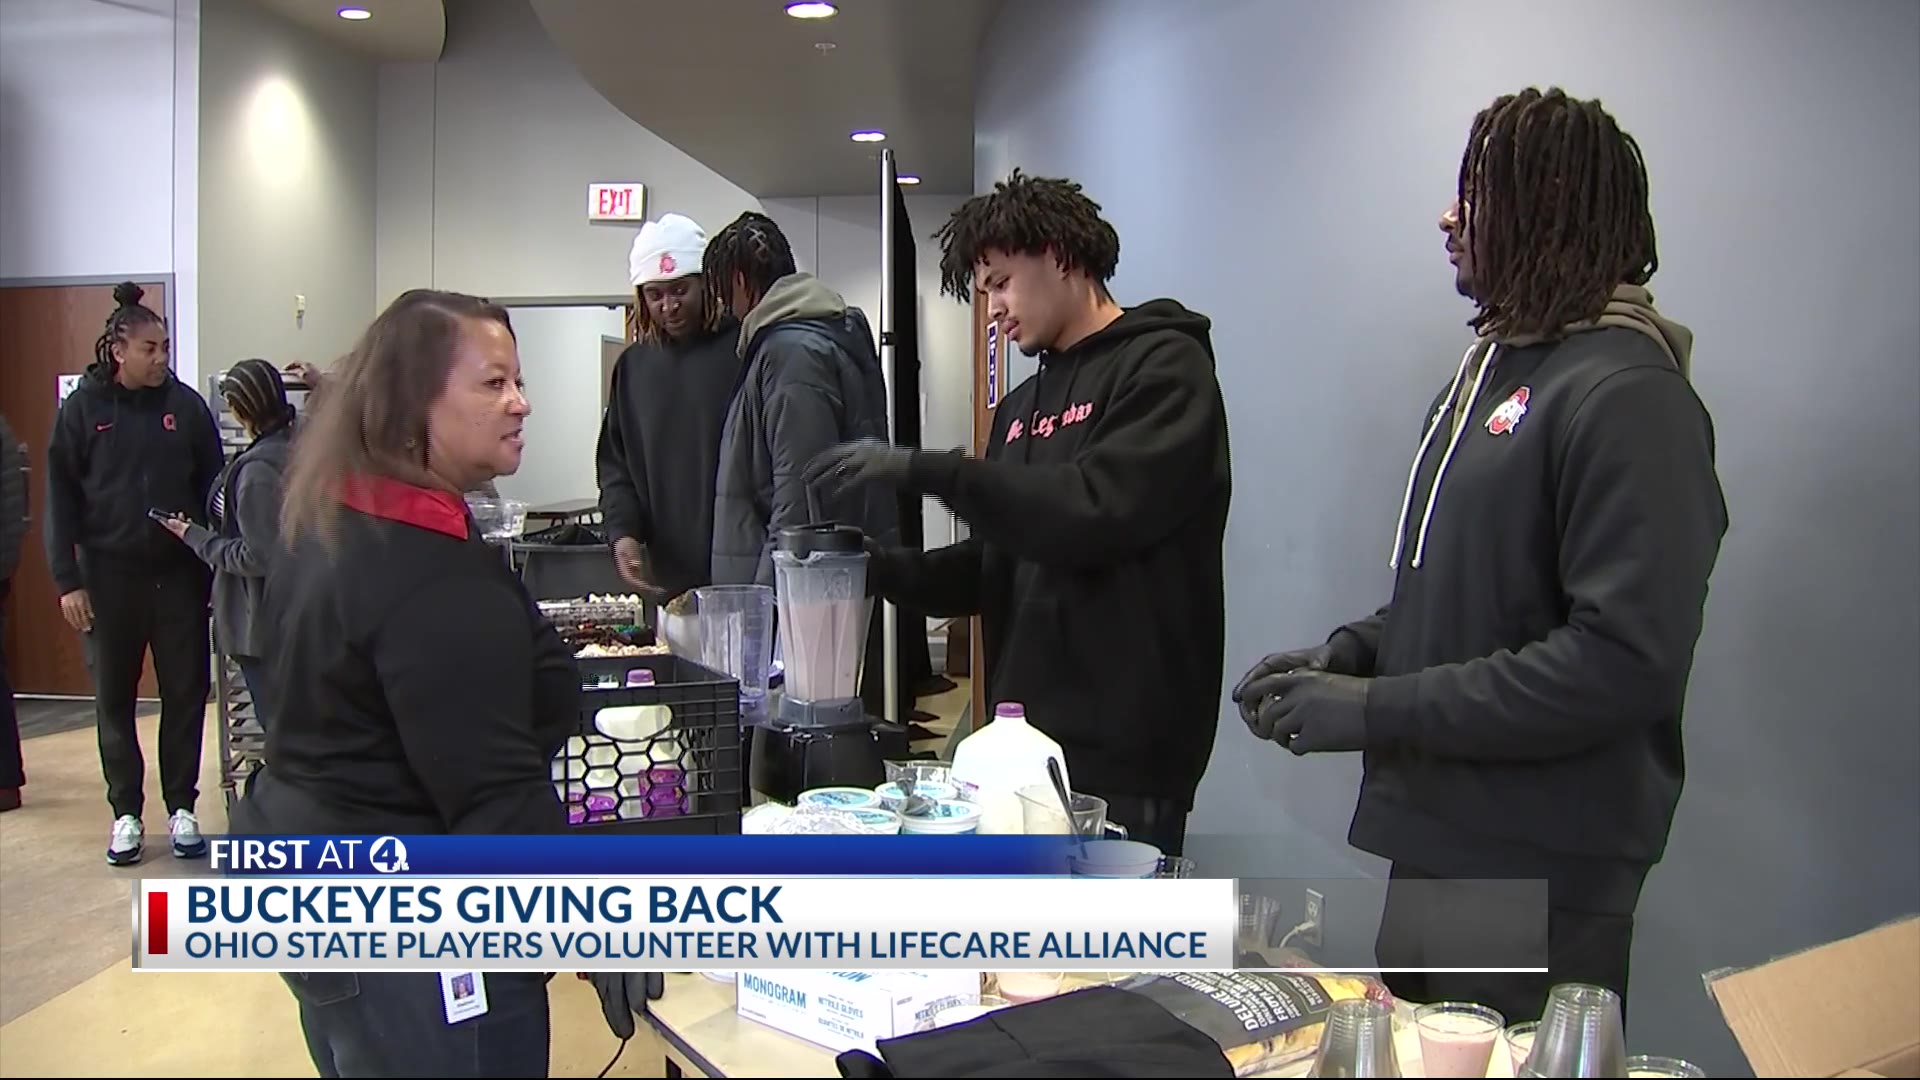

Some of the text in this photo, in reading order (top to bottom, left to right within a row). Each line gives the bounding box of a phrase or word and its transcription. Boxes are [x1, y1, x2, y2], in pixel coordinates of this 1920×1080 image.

[599, 189, 633, 215] EXIT
[743, 972, 807, 1010] MONOGRAM
[1175, 974, 1218, 994] MIXED
[1211, 989, 1259, 1031] DELUXE
